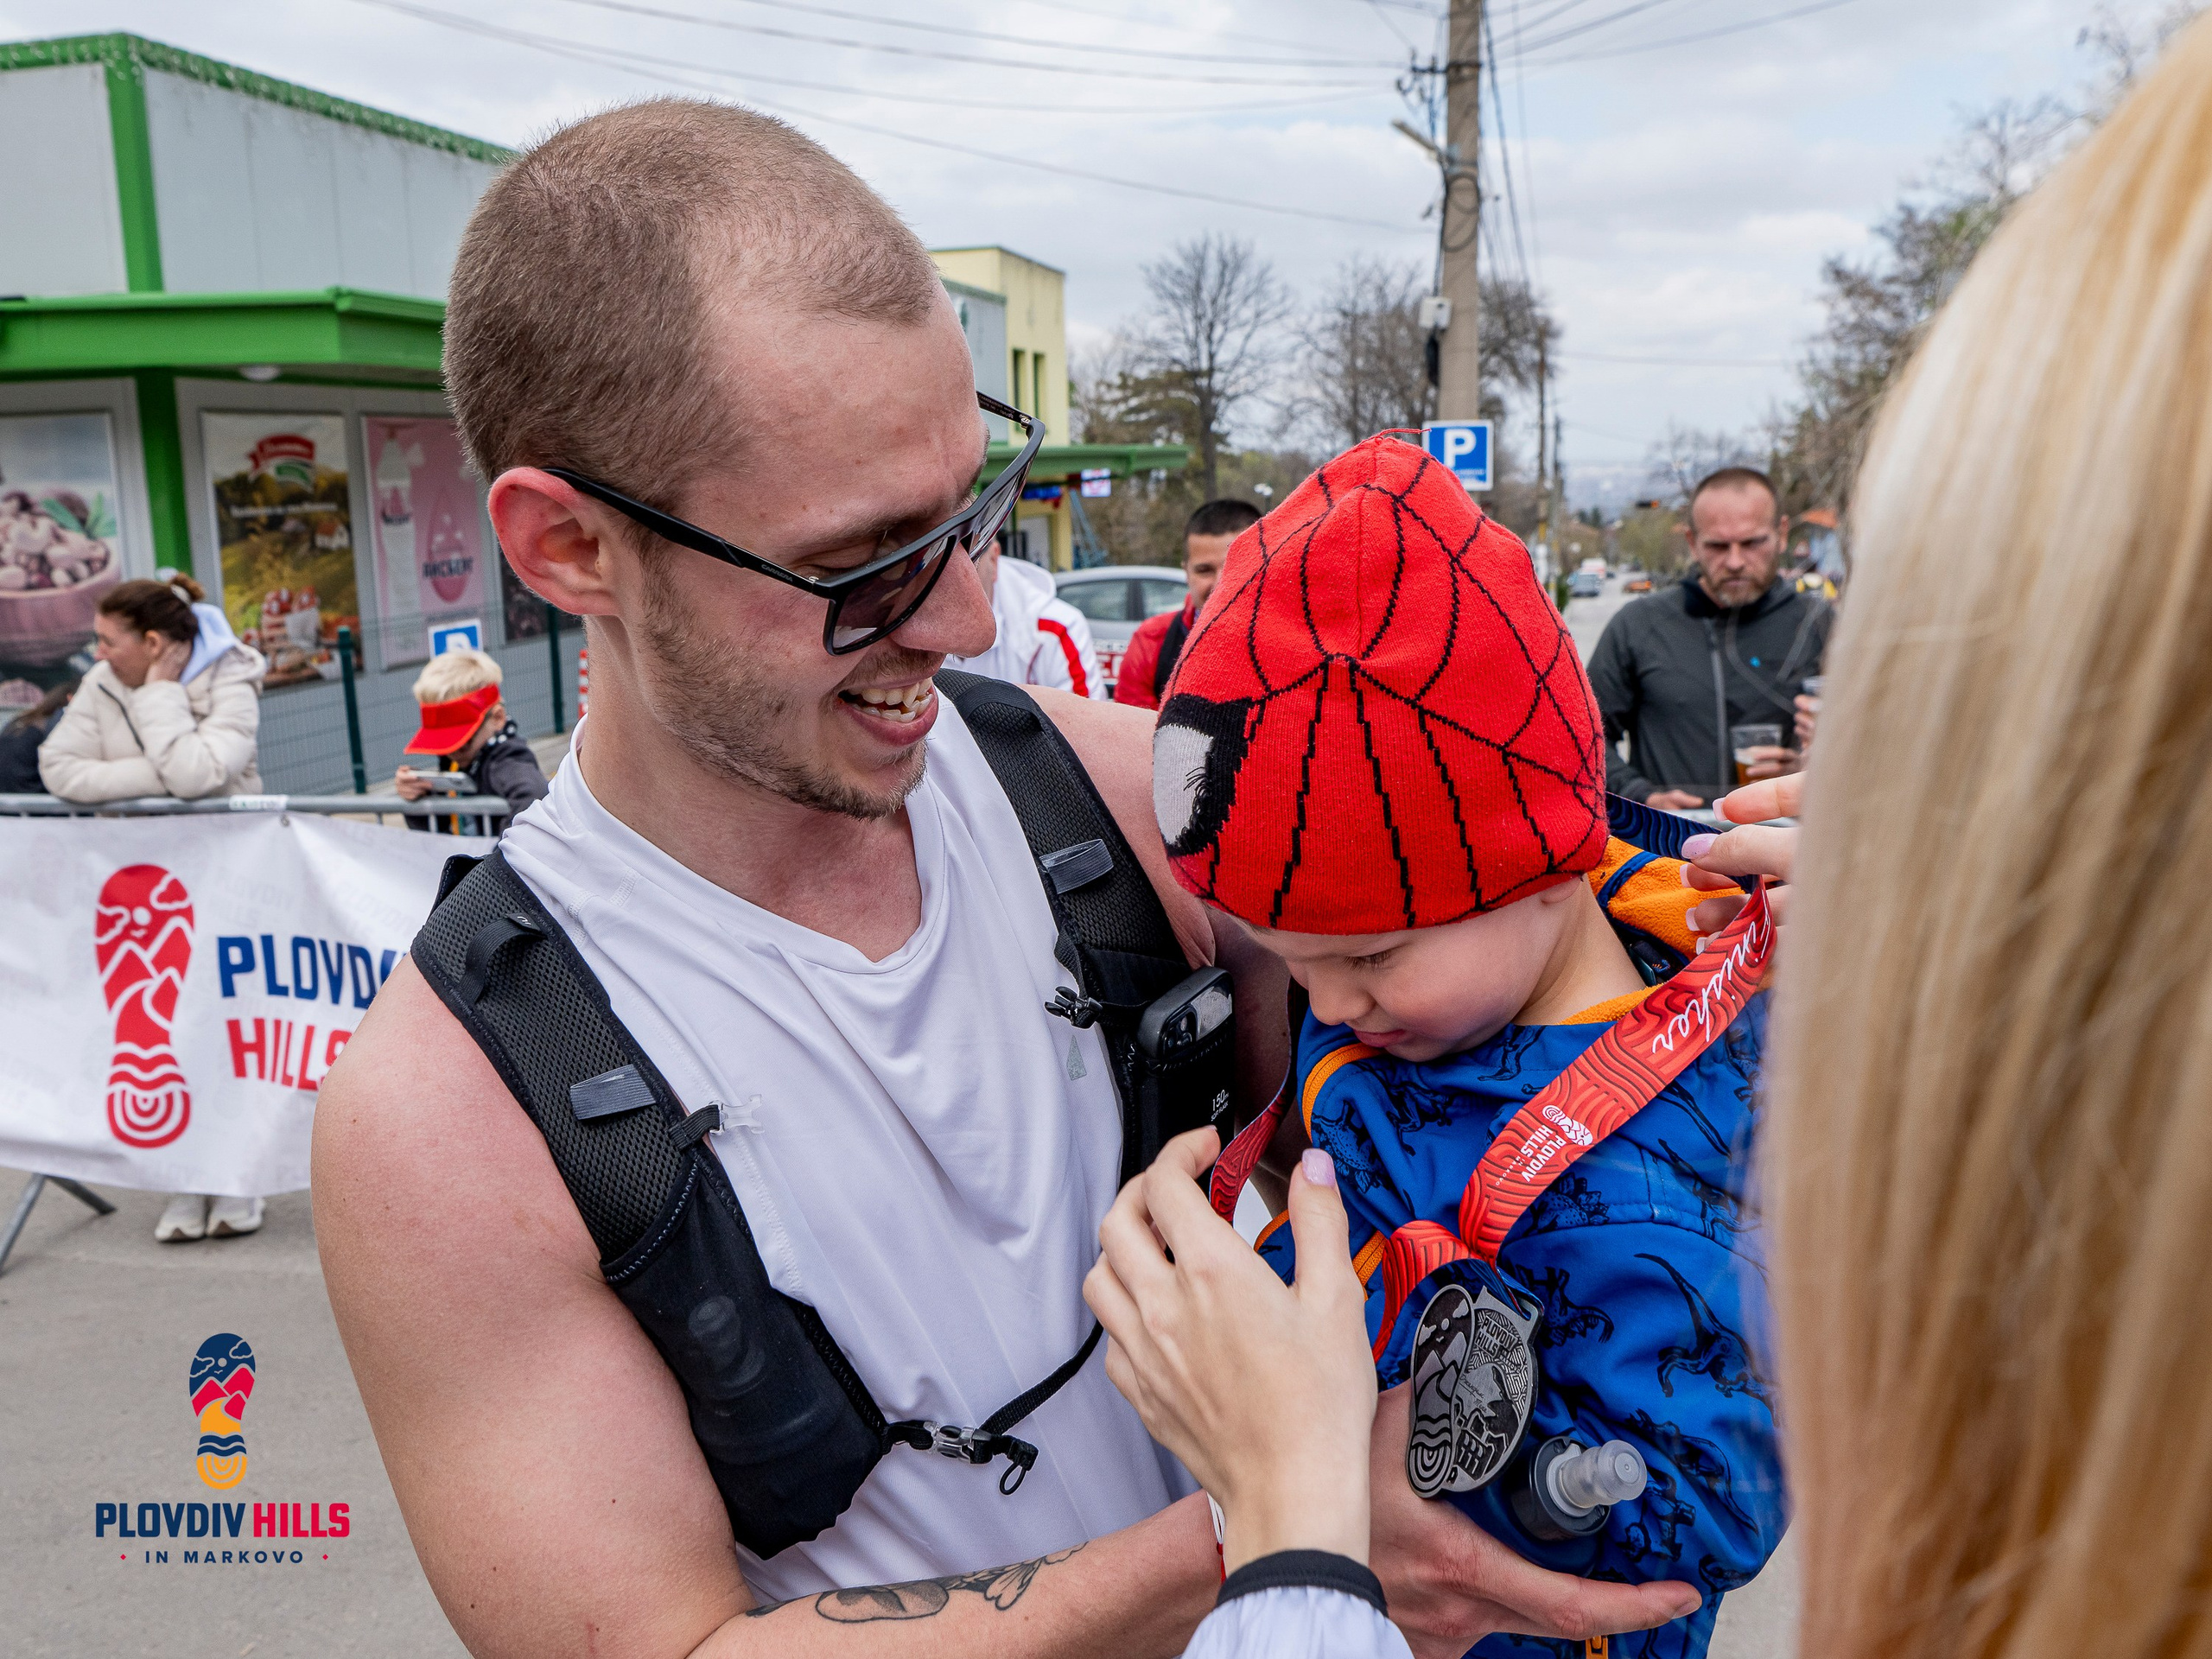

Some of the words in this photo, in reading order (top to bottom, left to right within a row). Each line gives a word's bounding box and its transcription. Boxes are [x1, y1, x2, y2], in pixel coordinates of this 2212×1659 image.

[1444, 429, 1477, 469] P
[217, 934, 410, 1010] PLOVDI
[1652, 889, 1771, 1054] Finisher
[1520, 1124, 1554, 1158] HILLS
[1522, 1134, 1567, 1183] PLOVDIV
[1475, 1331, 1499, 1357] HILLS
[1481, 1316, 1517, 1351] PLOVDIV
